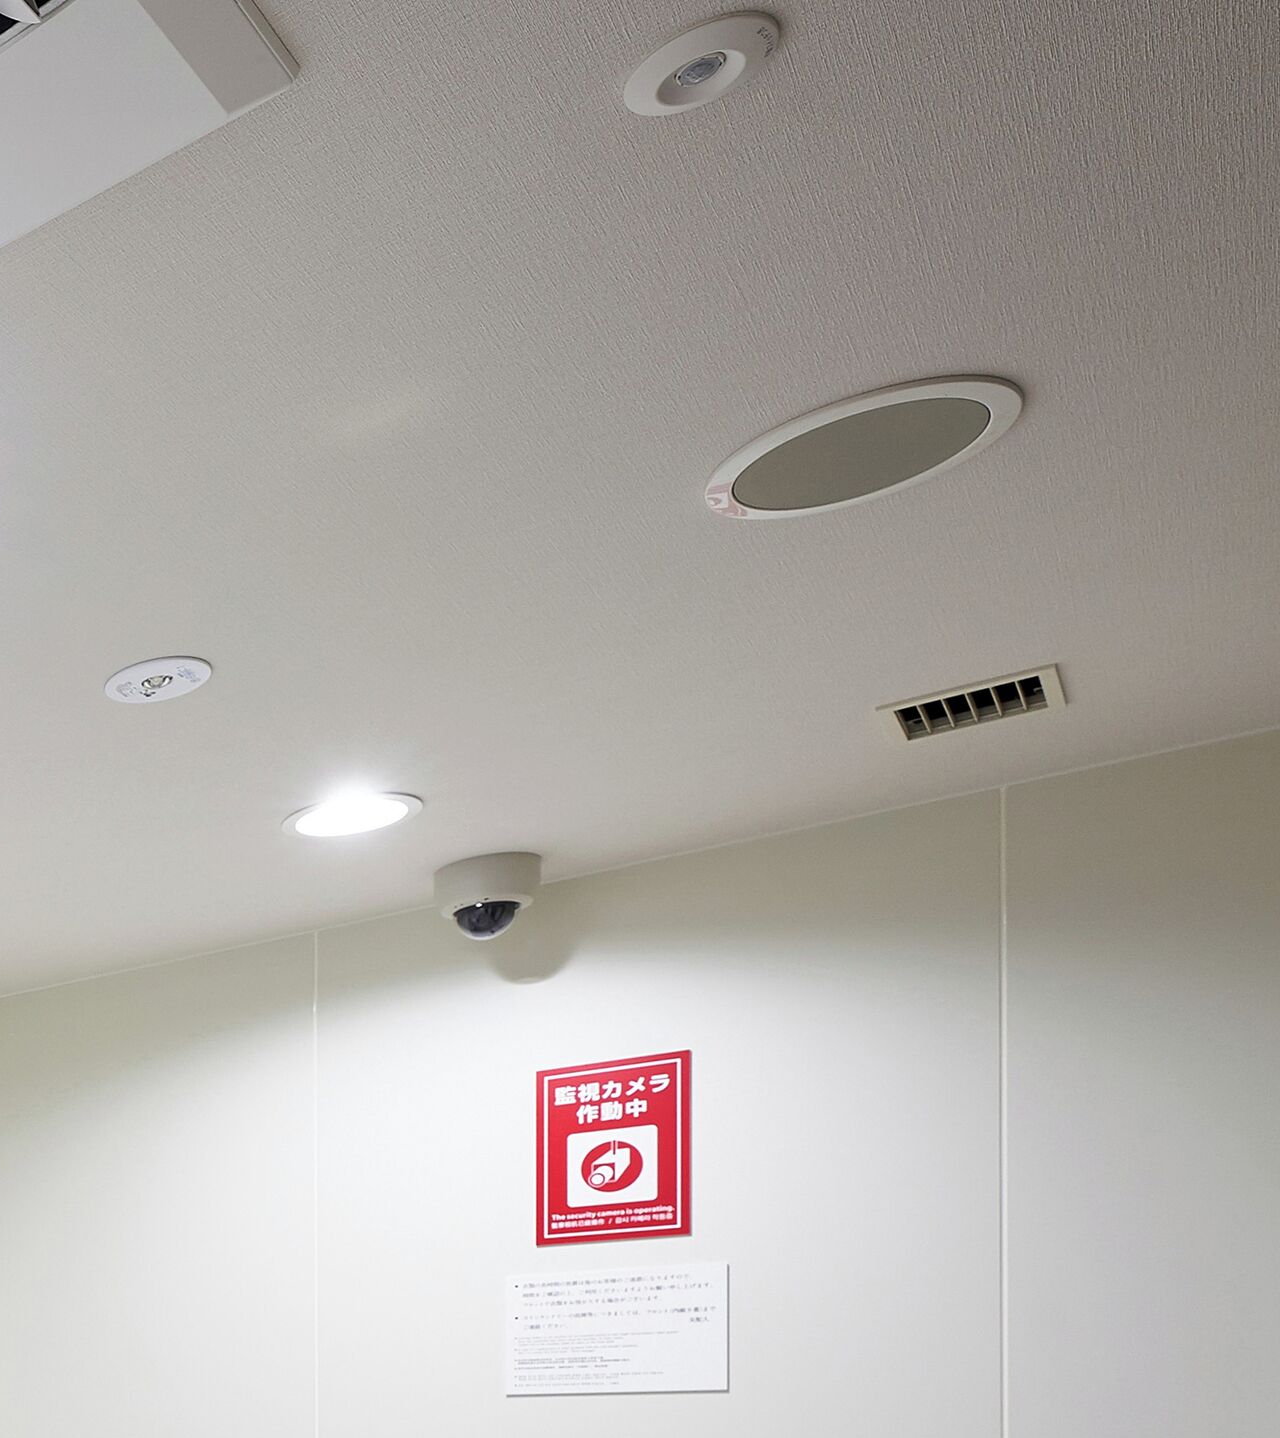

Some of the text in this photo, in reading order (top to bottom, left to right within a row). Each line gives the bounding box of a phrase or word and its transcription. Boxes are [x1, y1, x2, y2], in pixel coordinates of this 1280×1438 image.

[554, 1073, 671, 1106] 監視カメラ
[576, 1100, 648, 1125] 作動中
